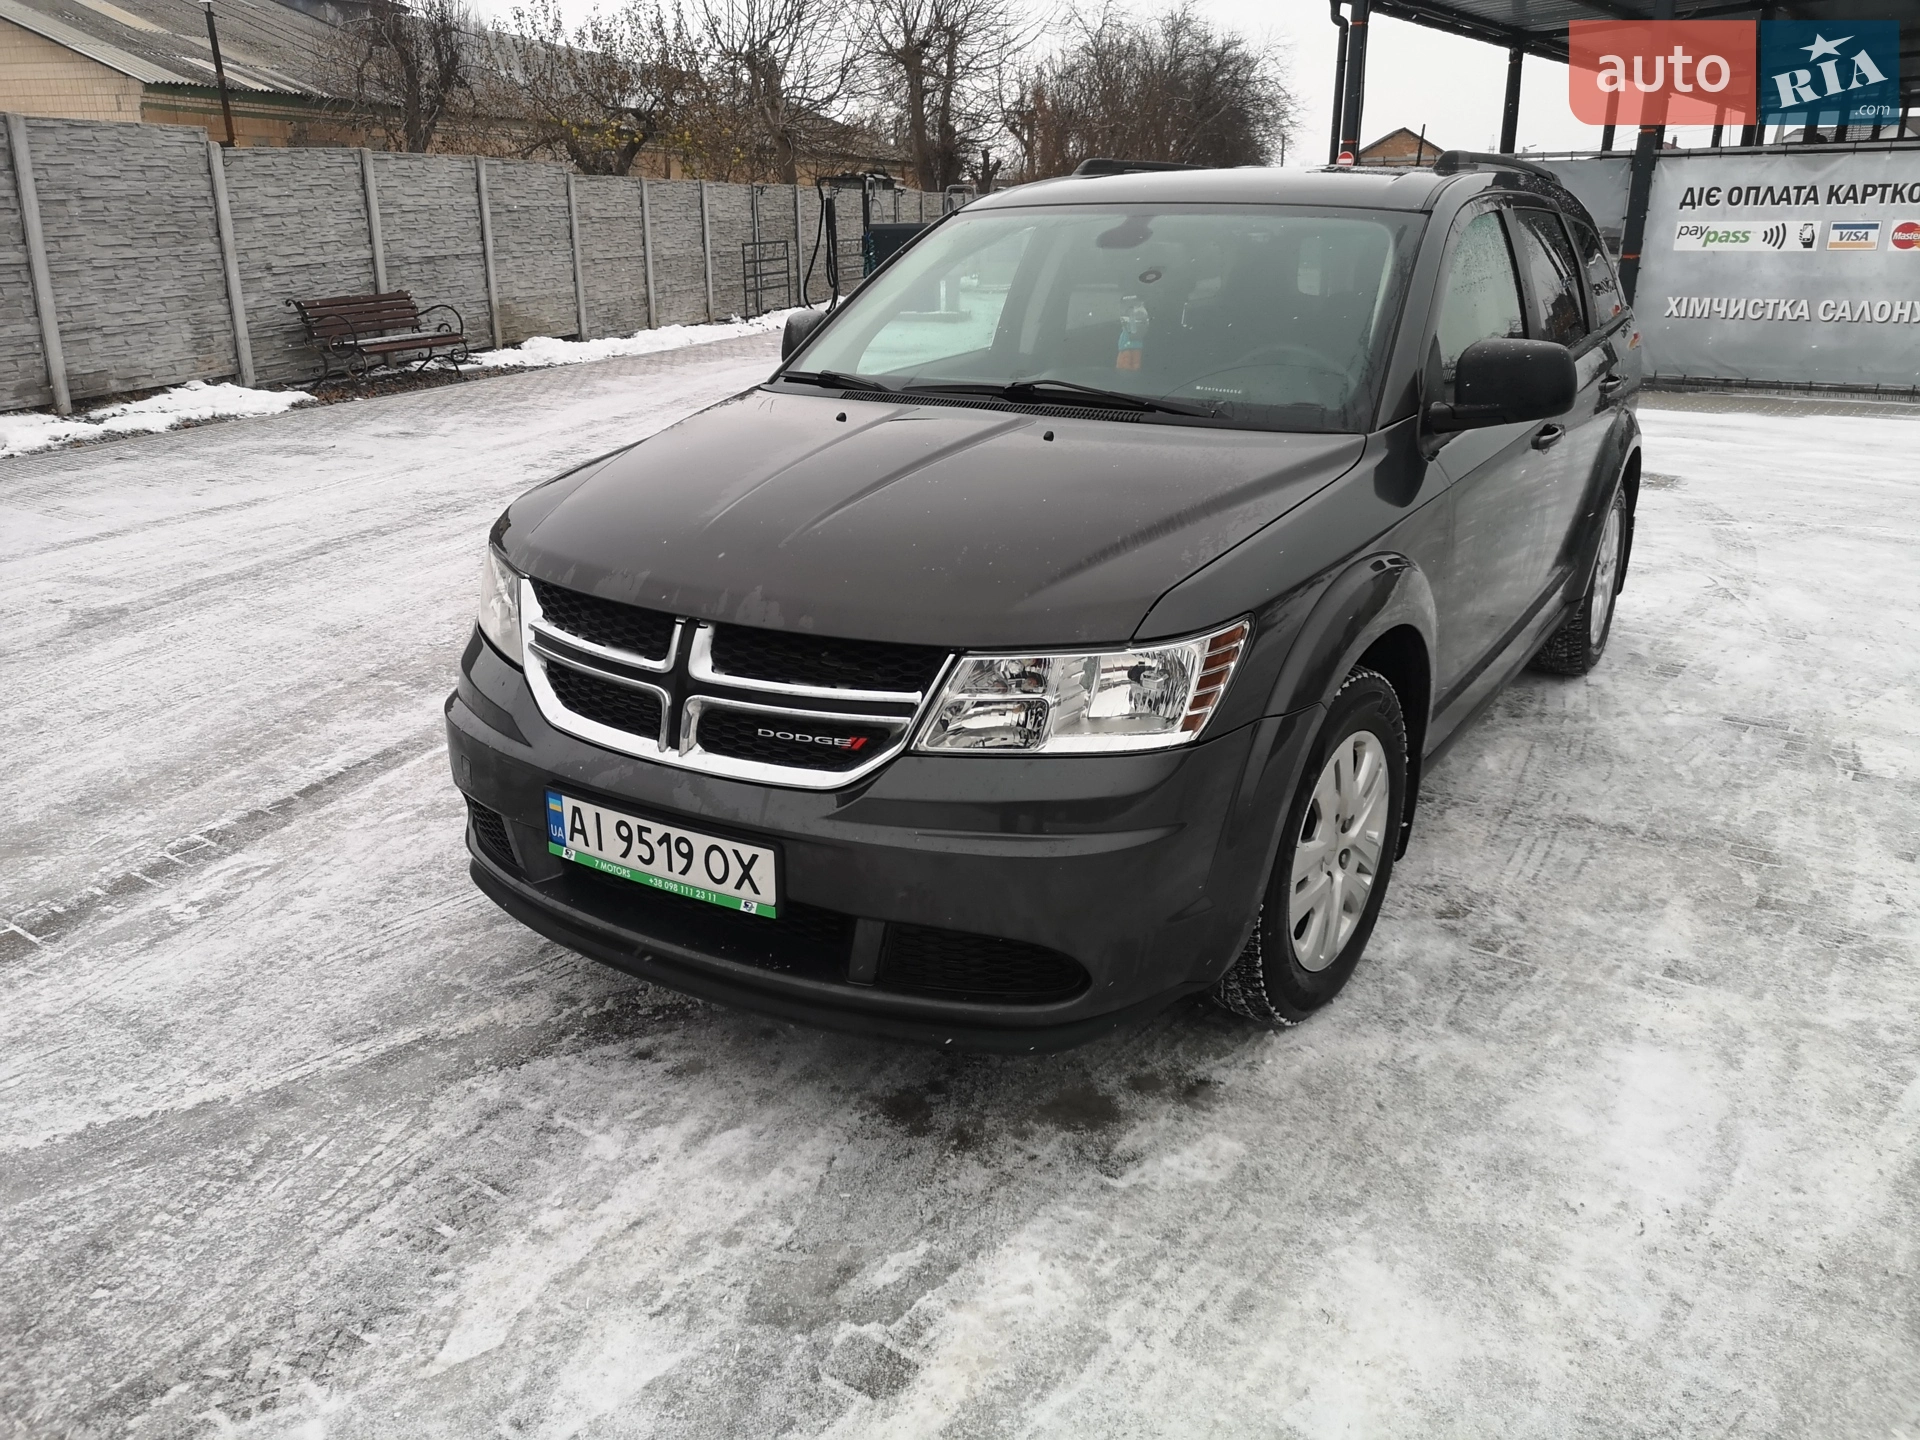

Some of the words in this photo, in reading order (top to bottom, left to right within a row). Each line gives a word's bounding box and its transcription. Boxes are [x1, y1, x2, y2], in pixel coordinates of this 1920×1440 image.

[1678, 186, 1722, 210] ДІЄ
[1727, 185, 1820, 207] ОПЛАТА
[1838, 230, 1869, 242] VISA
[1664, 296, 1811, 322] ХІМЧИСТКА
[757, 728, 852, 747] DODGE
[550, 823, 565, 840] UA
[569, 805, 603, 852] AI
[615, 819, 694, 876] 9519
[704, 844, 761, 895] OX
[594, 859, 599, 867] 7
[600, 862, 631, 878] MOTORS
[648, 877, 663, 888] +38
[664, 881, 678, 892] 098
[680, 885, 693, 896] 111
[696, 889, 706, 899] 23
[708, 892, 717, 902] 11
